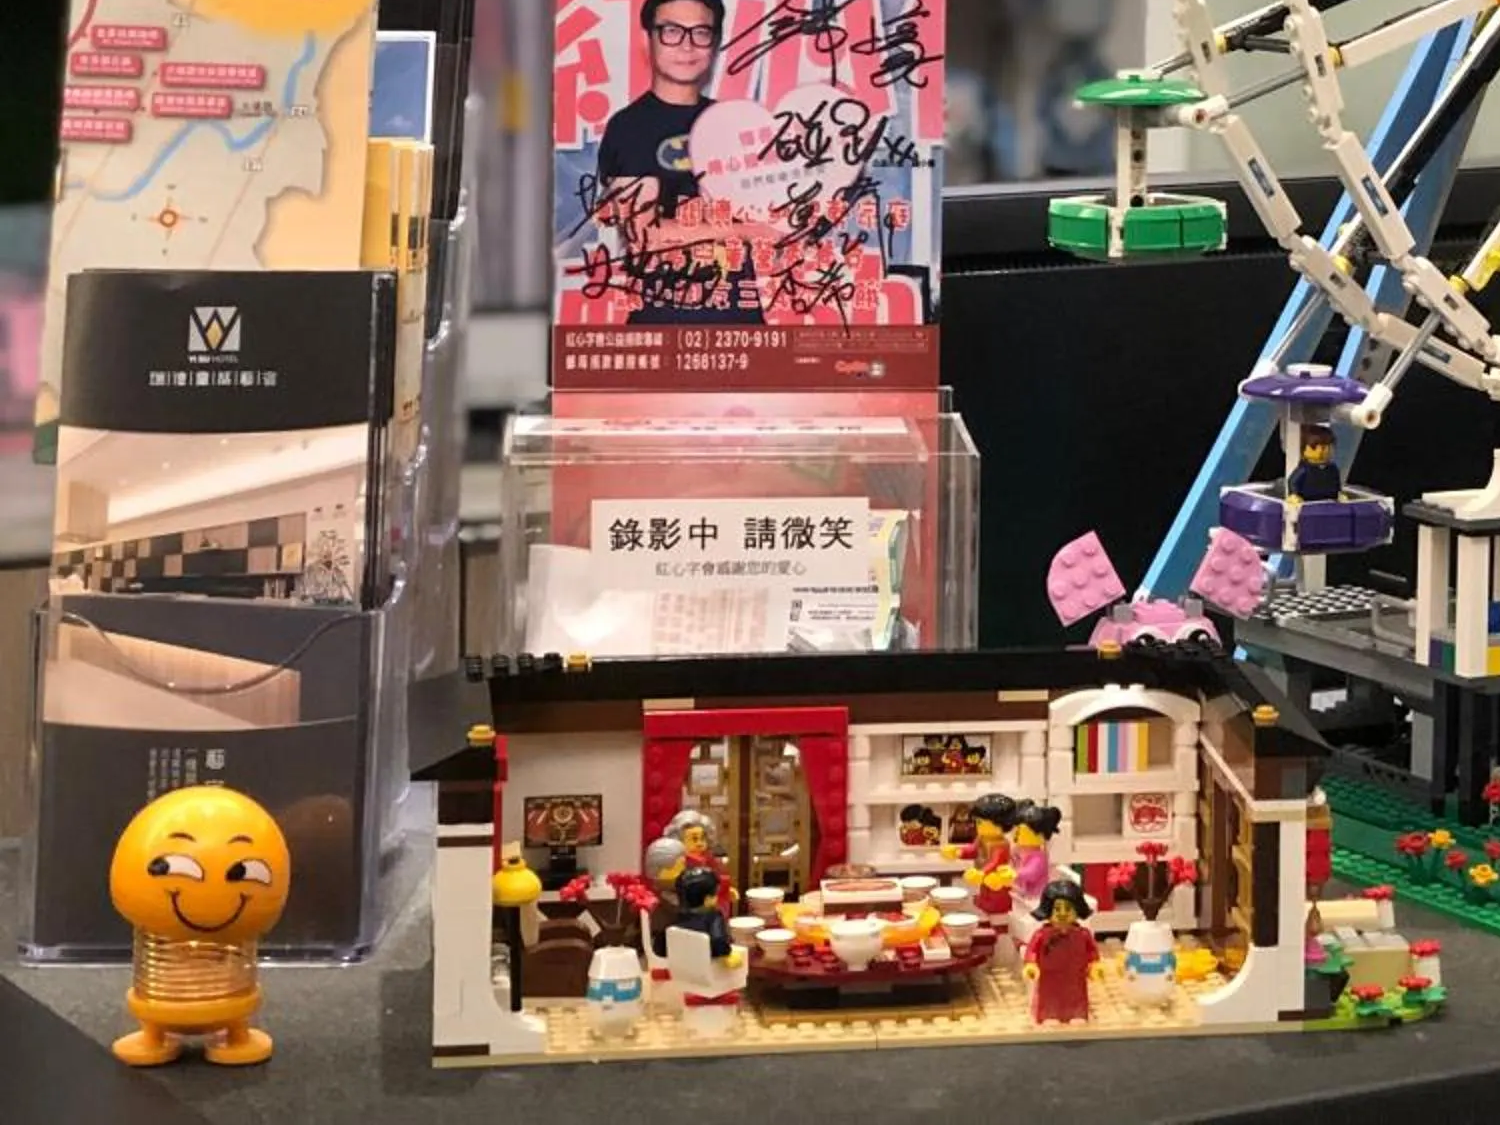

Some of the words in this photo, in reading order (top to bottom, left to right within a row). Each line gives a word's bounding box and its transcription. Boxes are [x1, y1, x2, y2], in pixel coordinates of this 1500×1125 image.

[608, 516, 718, 551] 錄影中
[743, 516, 854, 551] 請微笑
